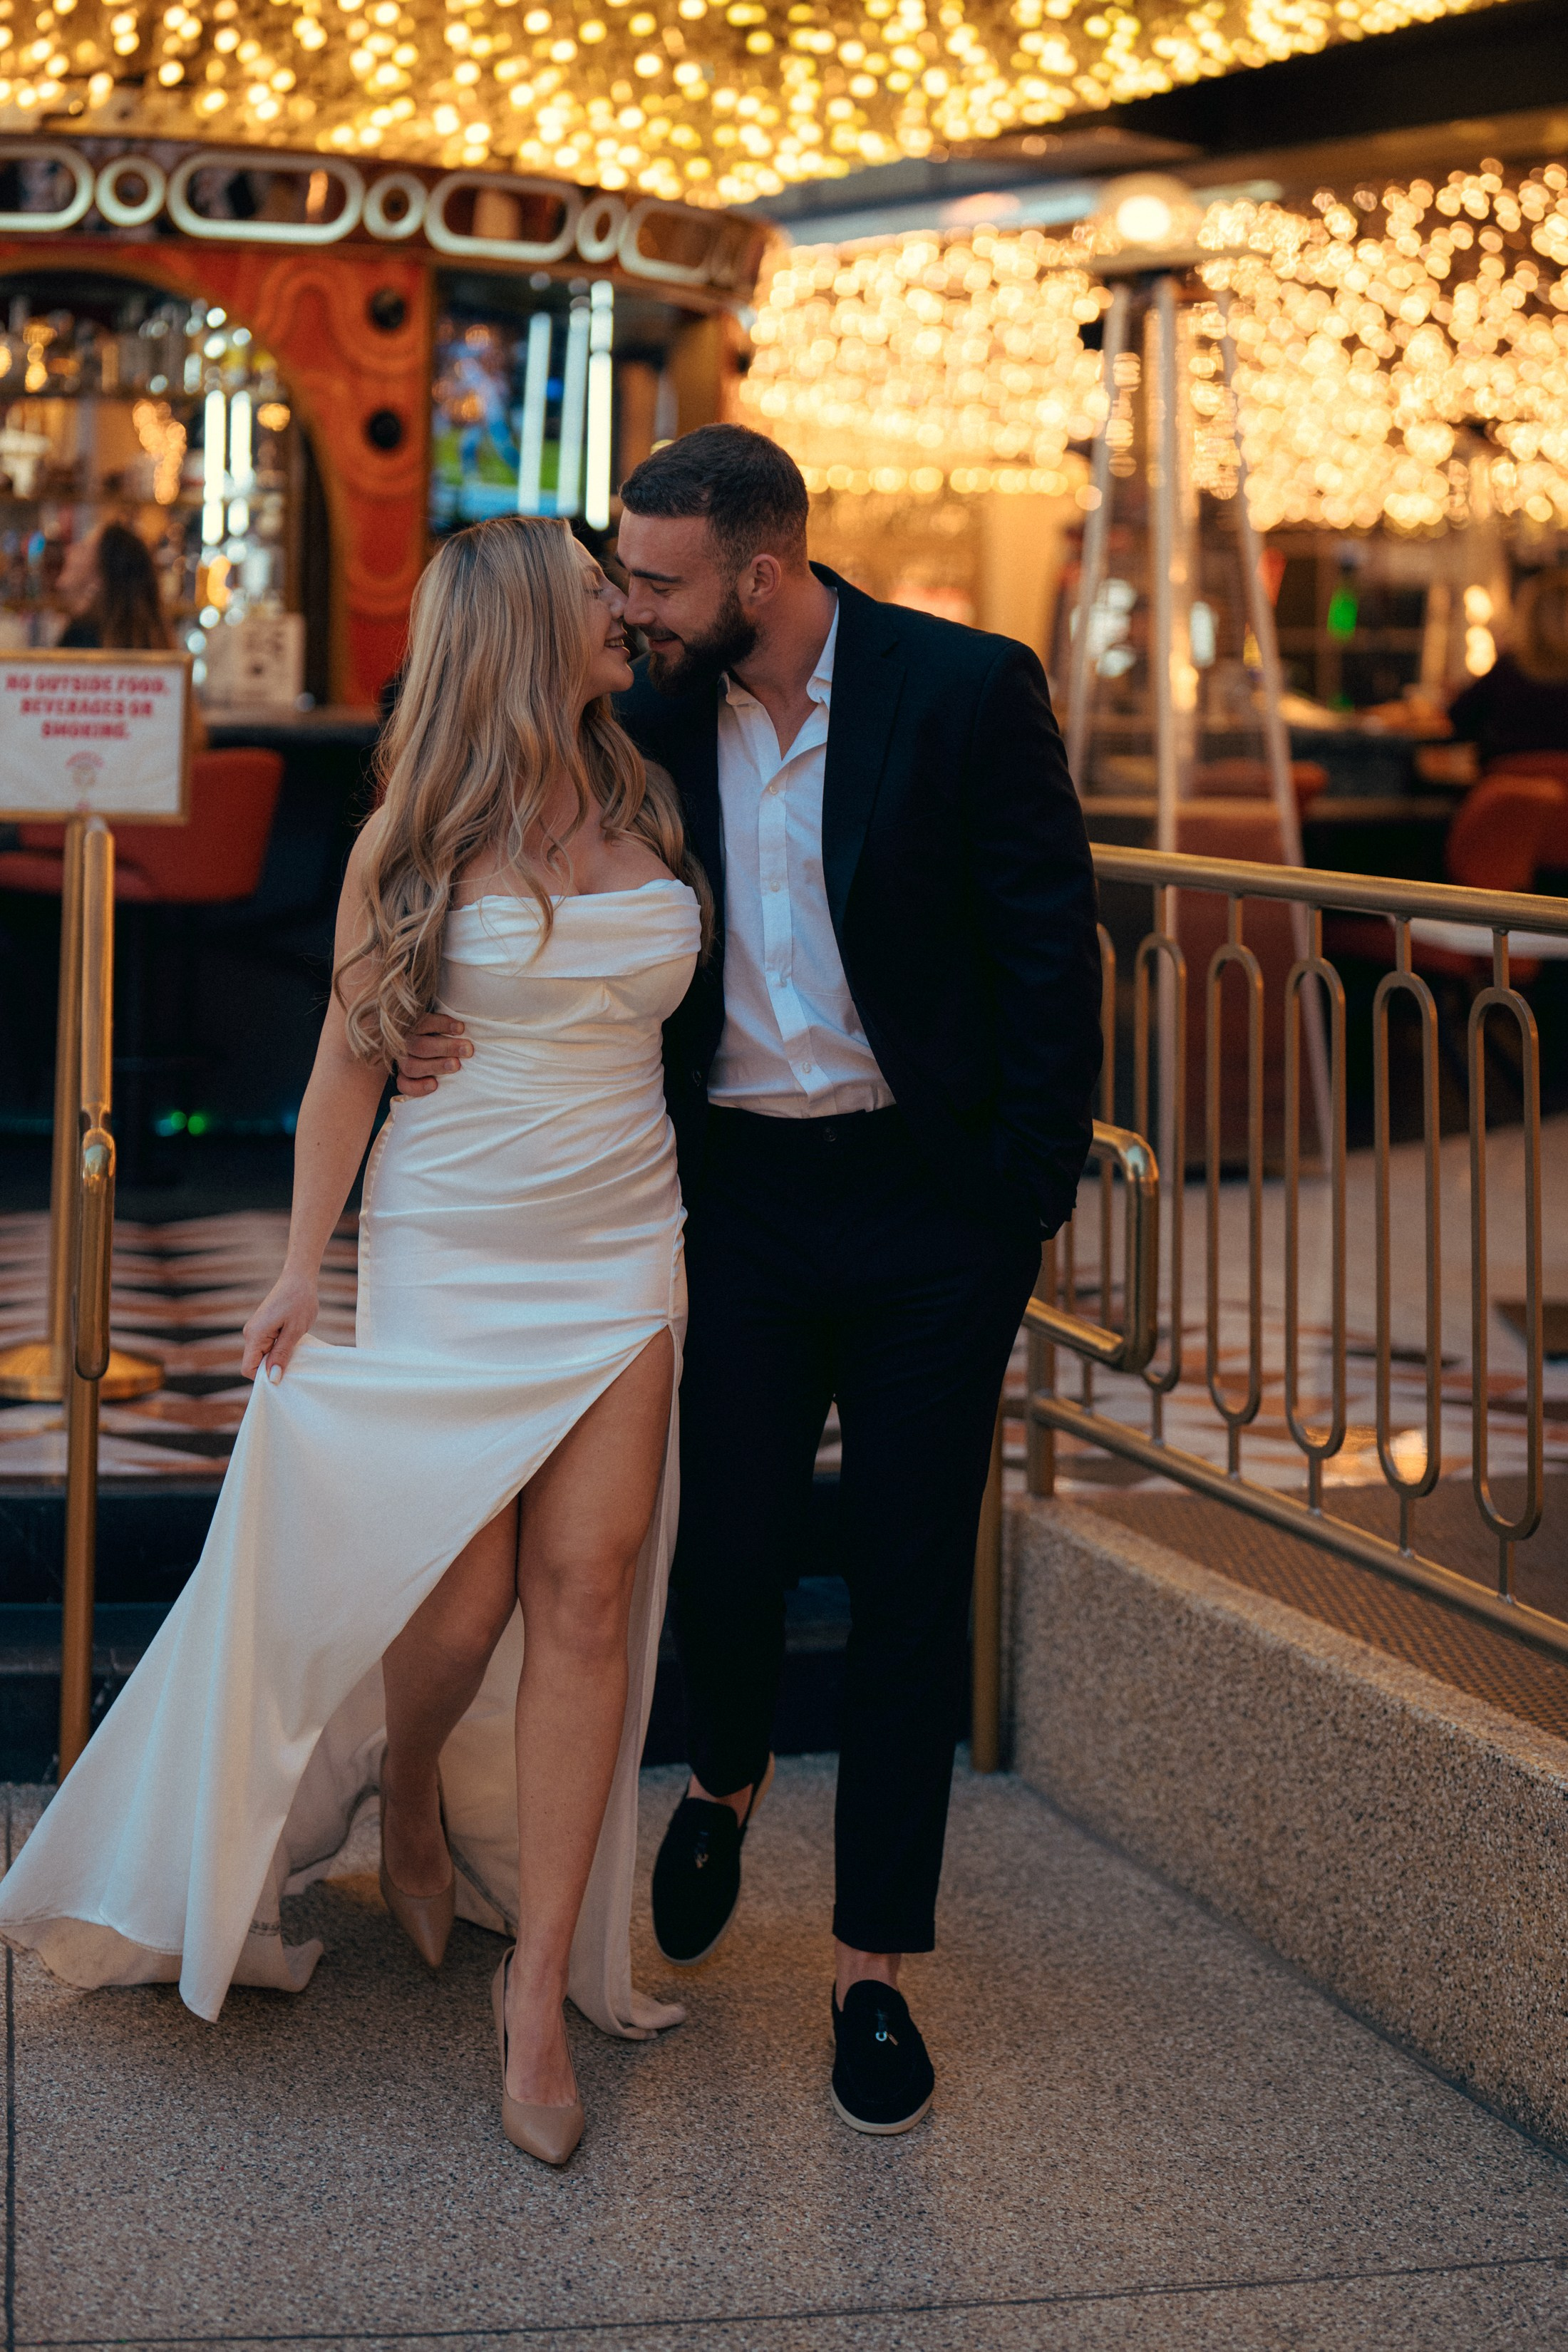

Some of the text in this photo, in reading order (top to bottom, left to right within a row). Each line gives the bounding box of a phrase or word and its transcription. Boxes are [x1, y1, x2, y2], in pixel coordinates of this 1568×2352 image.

[6, 674, 31, 691] NO
[36, 674, 112, 693] OUTSIDE
[21, 698, 153, 716] BEVERAGES OR
